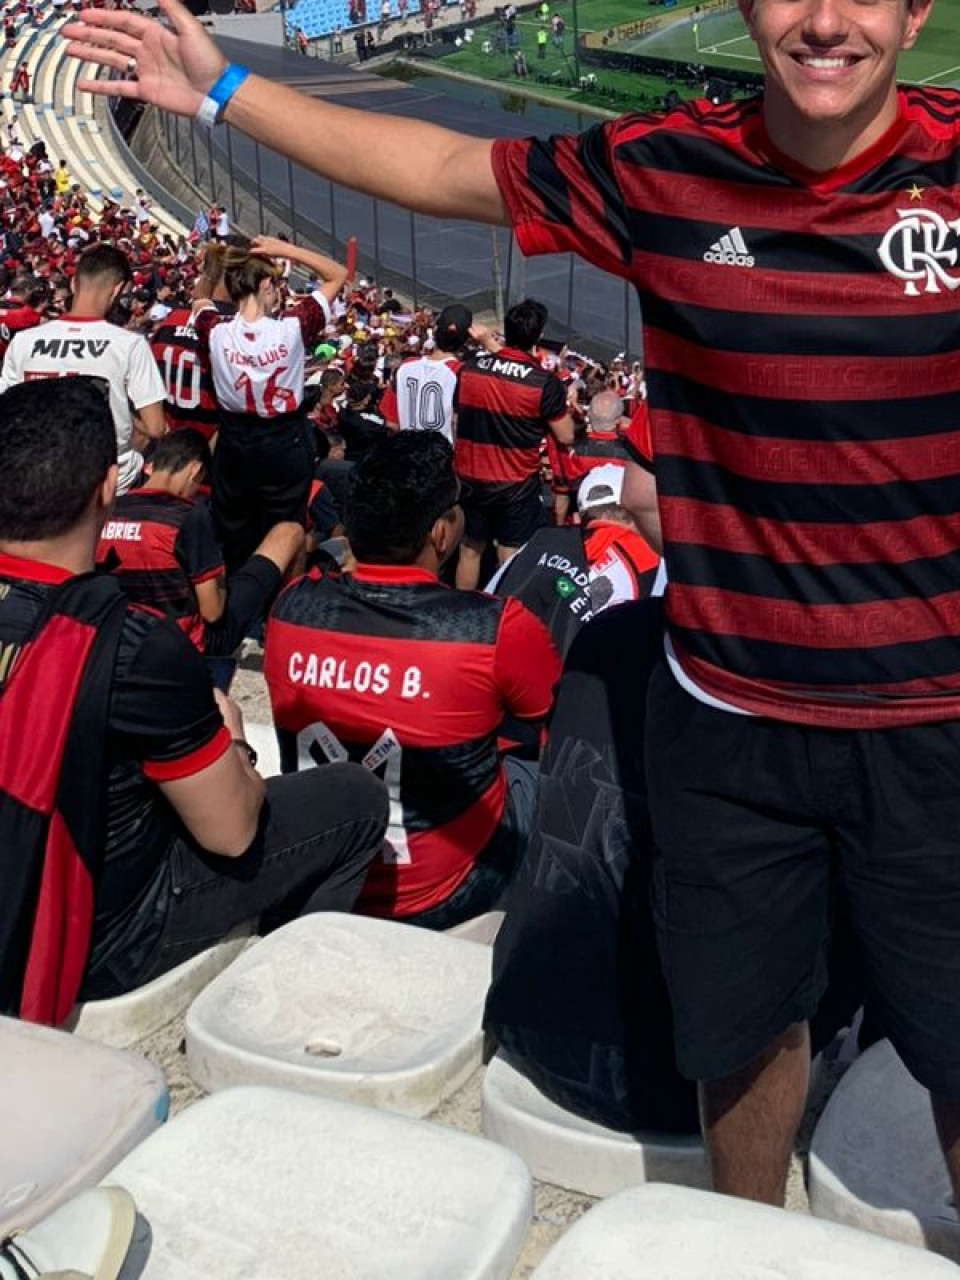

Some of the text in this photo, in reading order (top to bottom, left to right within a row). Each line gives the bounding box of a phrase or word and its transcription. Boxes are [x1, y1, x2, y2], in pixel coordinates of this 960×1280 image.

[704, 251, 756, 269] adidas
[31, 338, 112, 359] MRV
[163, 346, 202, 409] 10
[492, 358, 533, 379] MRV
[234, 366, 298, 417] 16
[406, 376, 446, 431] 10
[101, 521, 142, 541] ABRIEL
[288, 651, 431, 699] CARLOS B.
